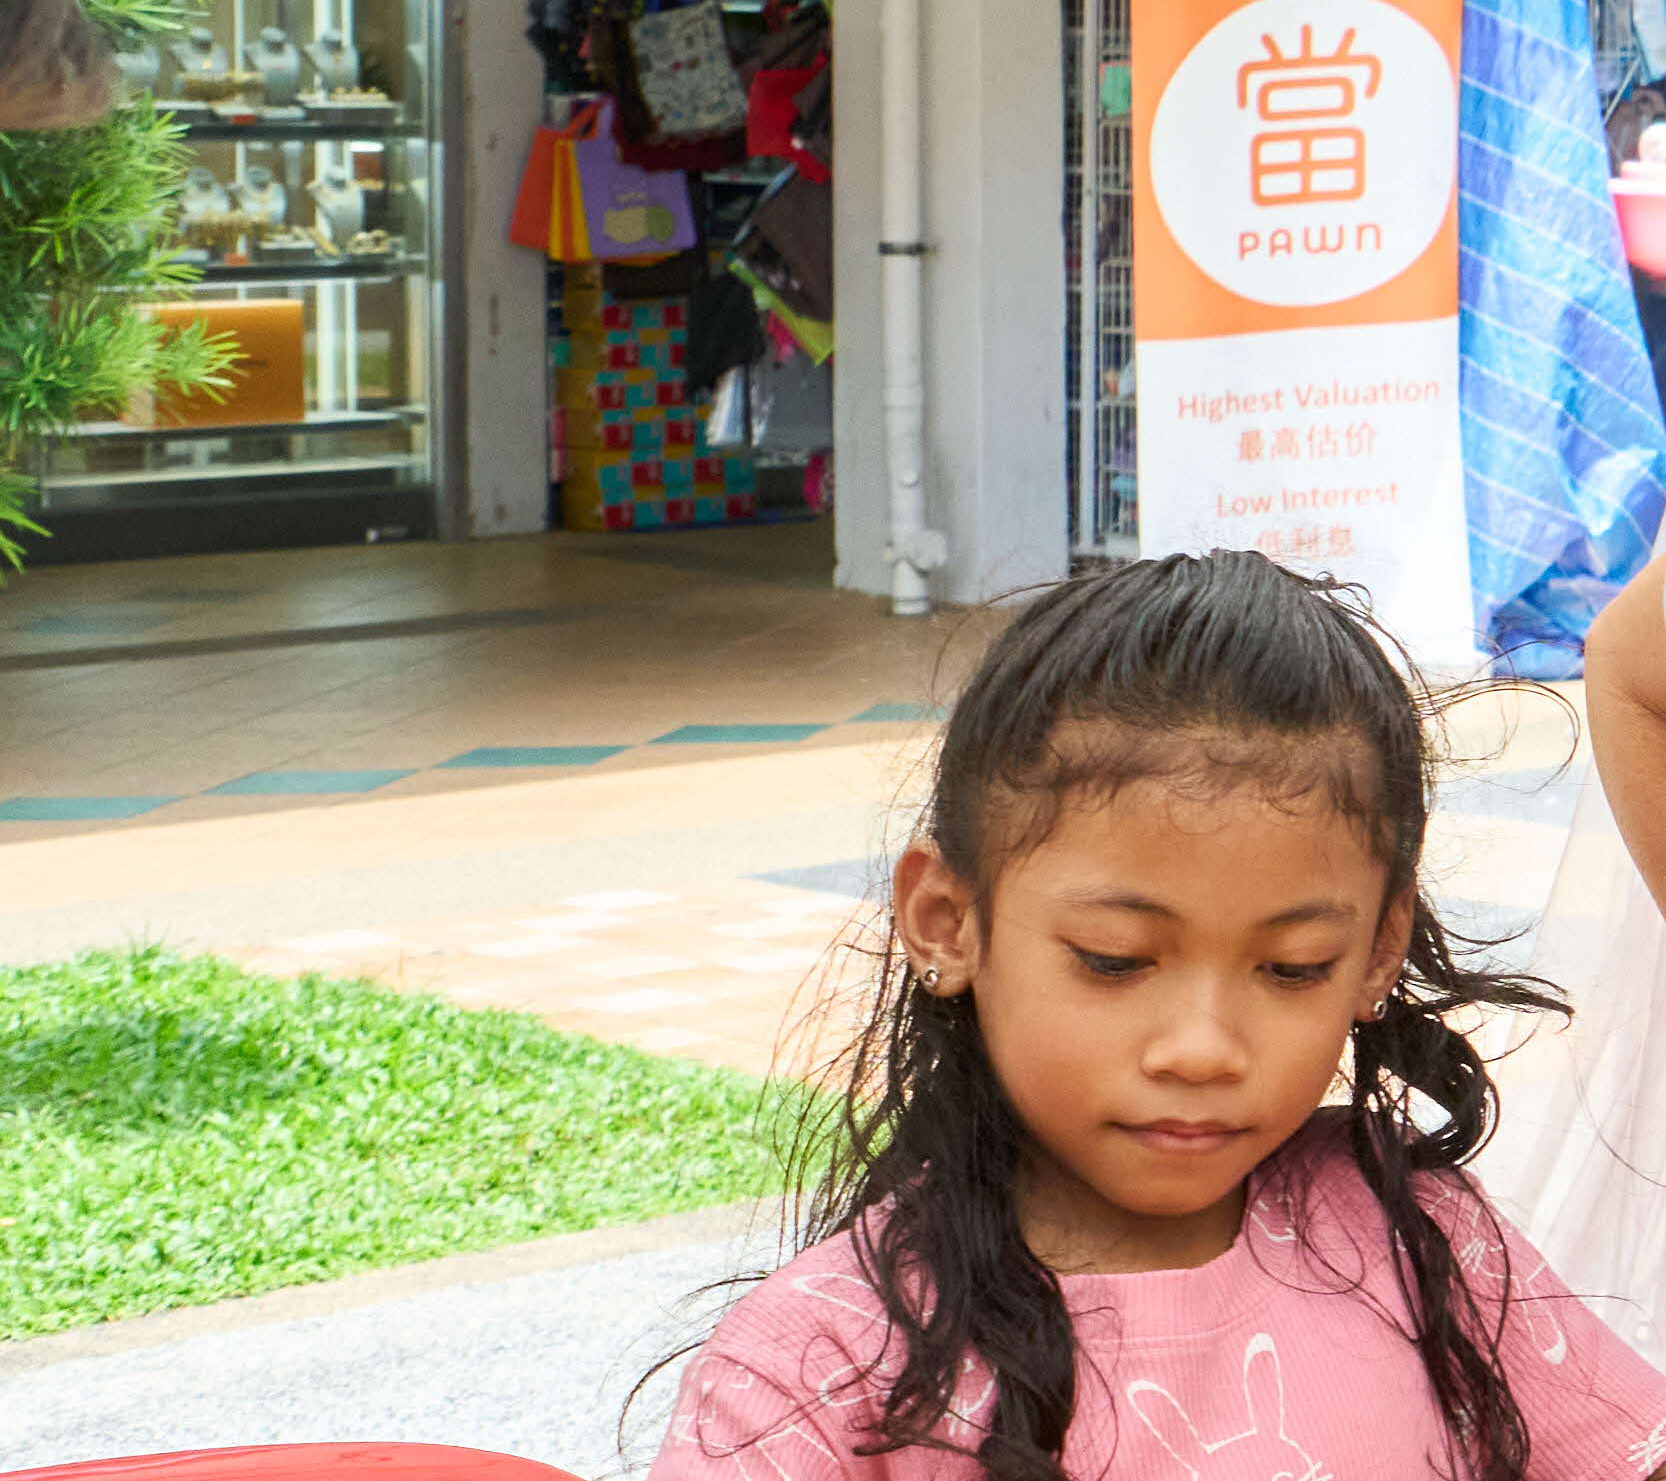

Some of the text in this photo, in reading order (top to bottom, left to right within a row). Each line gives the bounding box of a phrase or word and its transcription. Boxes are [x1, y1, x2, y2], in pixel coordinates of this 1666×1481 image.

[1237, 223, 1382, 260] PAWN
[1176, 378, 1441, 424] Highest Valuation
[1216, 482, 1400, 518] Low Interest
